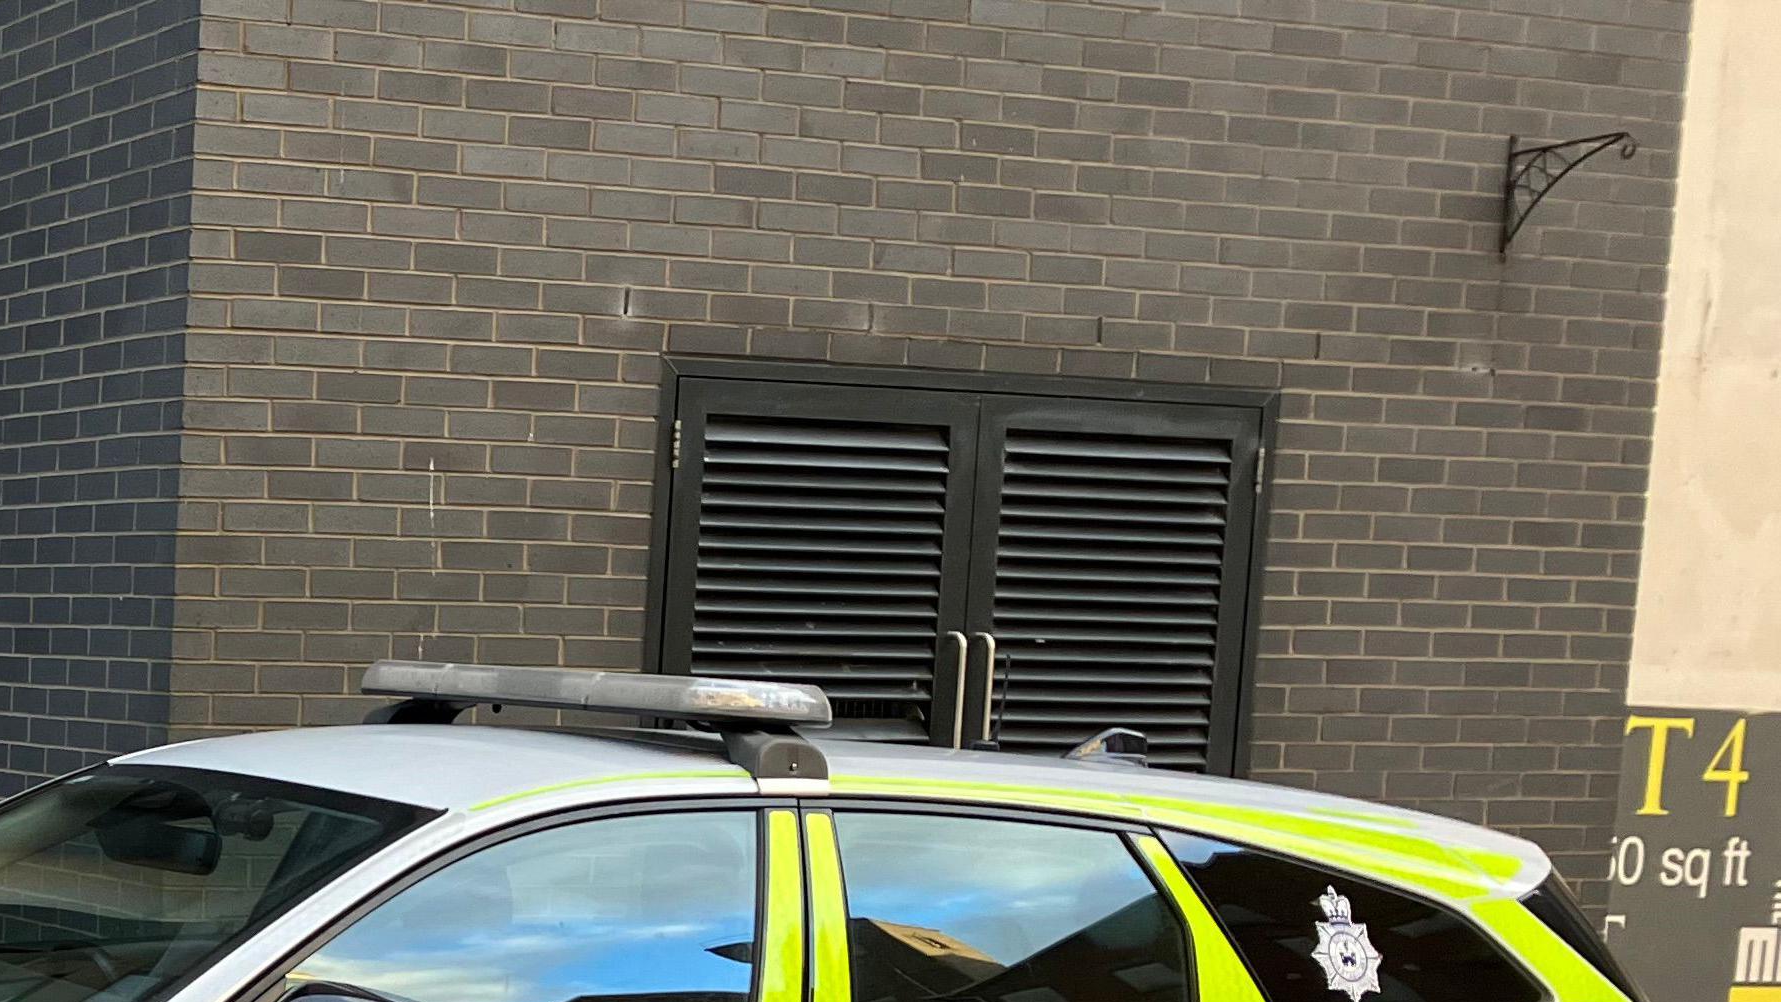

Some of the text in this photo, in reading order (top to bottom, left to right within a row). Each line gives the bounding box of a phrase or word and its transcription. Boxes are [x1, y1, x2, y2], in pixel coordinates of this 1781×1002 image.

[1702, 718, 1750, 817] 4
[1660, 847, 1712, 899] sq
[1724, 836, 1752, 887] ft
